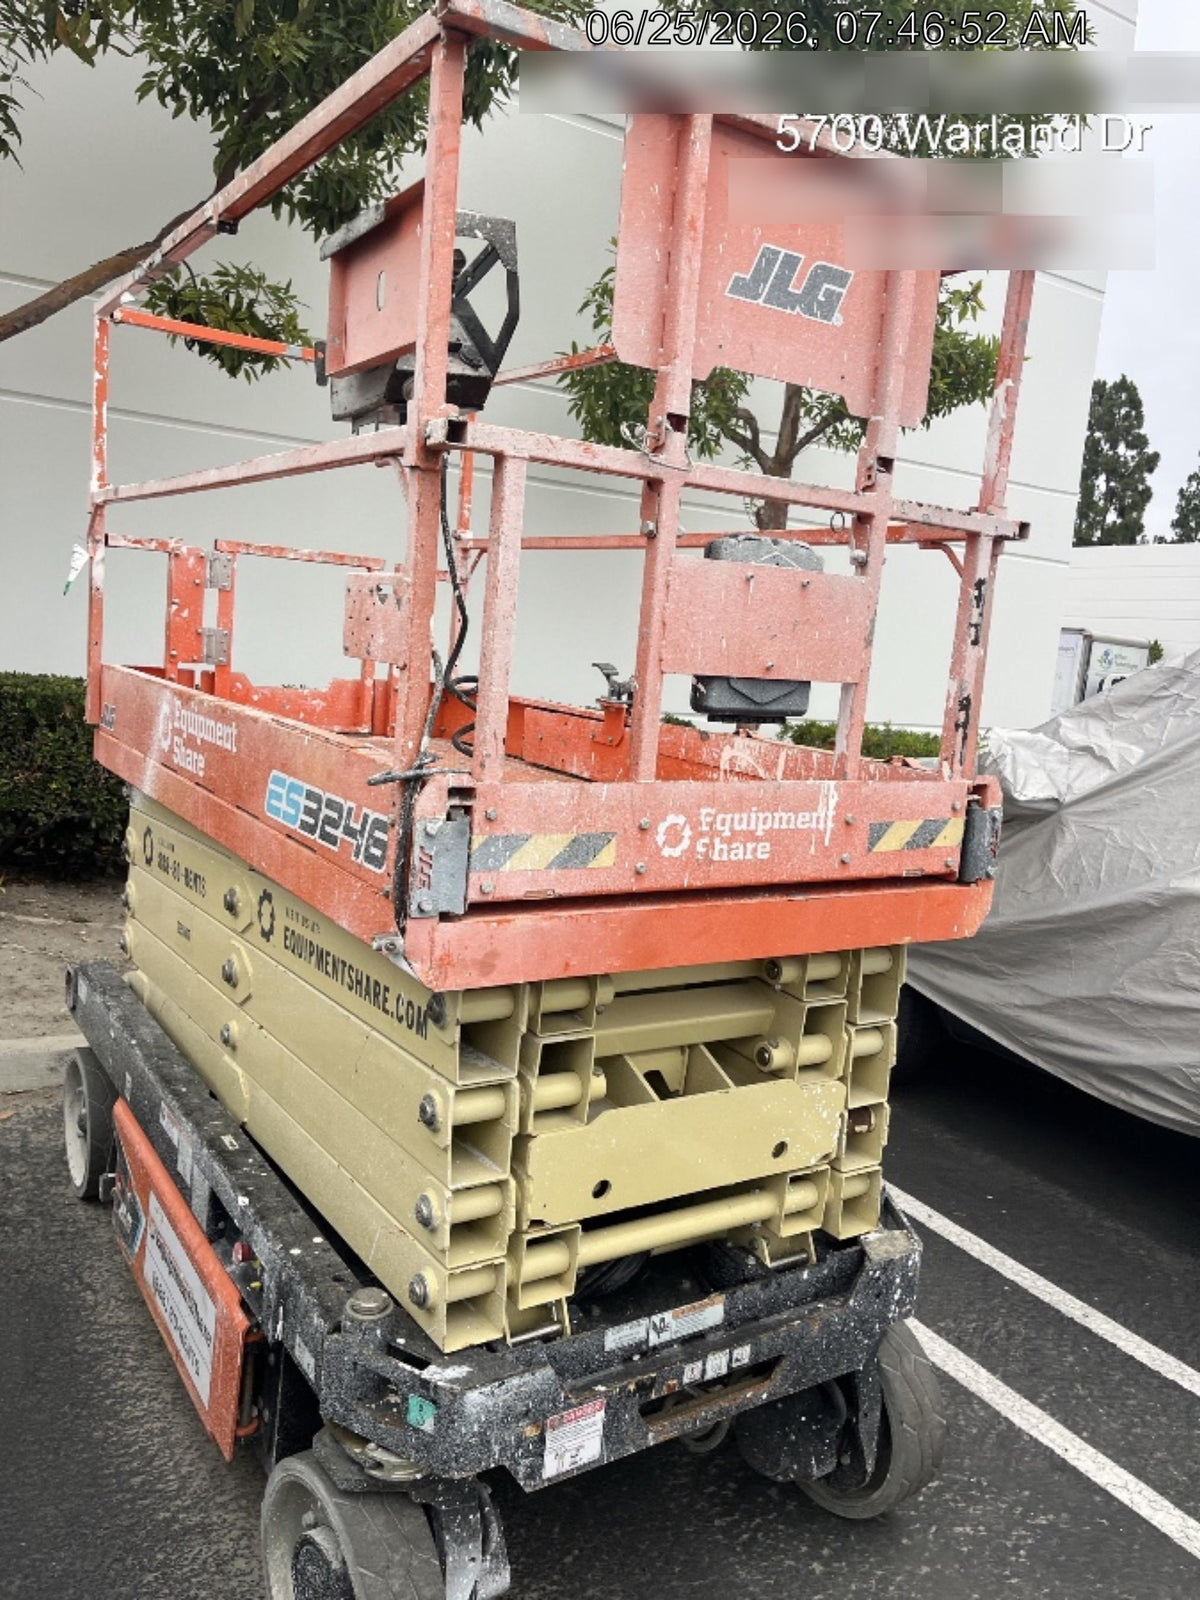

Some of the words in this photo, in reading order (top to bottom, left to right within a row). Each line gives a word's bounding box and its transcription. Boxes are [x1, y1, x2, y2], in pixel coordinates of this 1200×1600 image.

[724, 242, 854, 326] JLG
[173, 698, 238, 753] Equipment
[173, 735, 206, 778] Share
[264, 769, 390, 874] ES3246
[698, 805, 837, 837] Equipment
[695, 837, 771, 862] Share
[283, 925, 429, 1041] EQUIPMENTSHARE.COM
